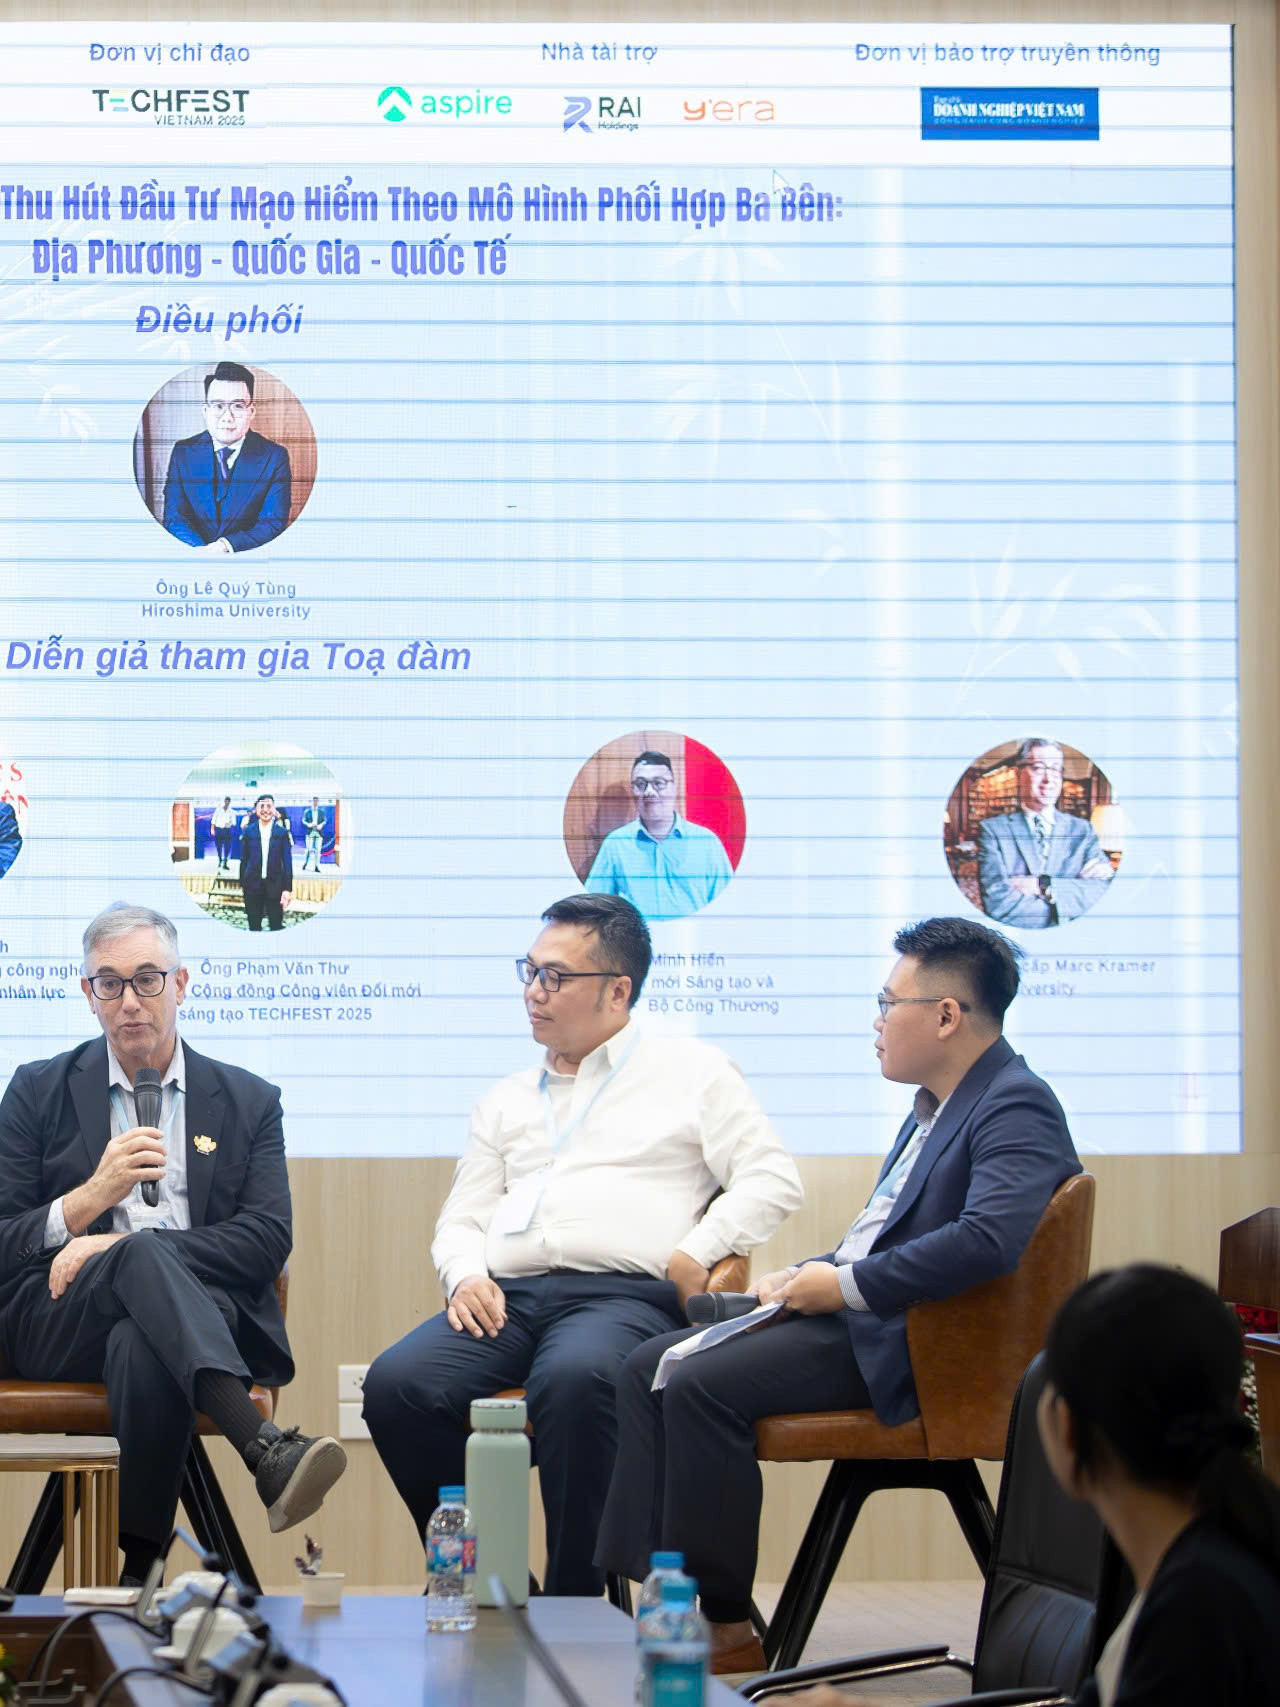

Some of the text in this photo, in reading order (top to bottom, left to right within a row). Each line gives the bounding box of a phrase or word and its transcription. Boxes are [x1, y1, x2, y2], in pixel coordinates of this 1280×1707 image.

[89, 43, 136, 62] Đơn
[144, 42, 162, 65] vị
[210, 42, 250, 65] đạo
[541, 42, 658, 64] Nhà tài trợ
[855, 43, 901, 62] Đơn
[908, 42, 927, 65] vị
[934, 42, 974, 62] bảo
[980, 44, 1015, 65] trợ
[1097, 42, 1161, 66] thông
[92, 89, 250, 112] TECHFEST
[420, 90, 513, 119] aspire
[598, 96, 641, 118] RAI
[154, 115, 246, 126] VIETNAM 2025
[0, 184, 53, 221] Thu
[62, 179, 111, 221] Hút
[120, 179, 175, 221] Đầu
[184, 186, 220, 221] Tư
[231, 186, 295, 230] Mạo
[304, 175, 378, 222] Hiểm
[388, 186, 461, 222] Theo
[468, 182, 514, 222] Mô
[524, 183, 588, 222] Hình
[598, 180, 661, 222] Phối
[671, 186, 725, 230] Hợp
[736, 186, 771, 222] Ba
[782, 182, 844, 222] Bên:
[32, 232, 513, 282] Địa Phương Quốc Gia Quốc Tế
[135, 301, 303, 341] Điều phối
[156, 579, 296, 598] Ông Lê Quý Tùng
[142, 603, 311, 620] Hiroshima University
[6, 634, 471, 678] Diễn giả tham gia Toạ đàm
[6, 962, 45, 980] công
[200, 958, 350, 977] Ông Phạm Văn Thư
[1099, 960, 1156, 972] Kramer
[41, 985, 66, 1001] lực
[191, 984, 232, 1000] Cộng
[236, 983, 275, 1000] đồng
[280, 983, 320, 1000] Công
[325, 983, 357, 998] viên
[392, 983, 422, 998] mới
[179, 1006, 372, 1024] sáng tạo TECHFEST 2025
[673, 998, 713, 1015] Công
[719, 999, 779, 1015] Thương
